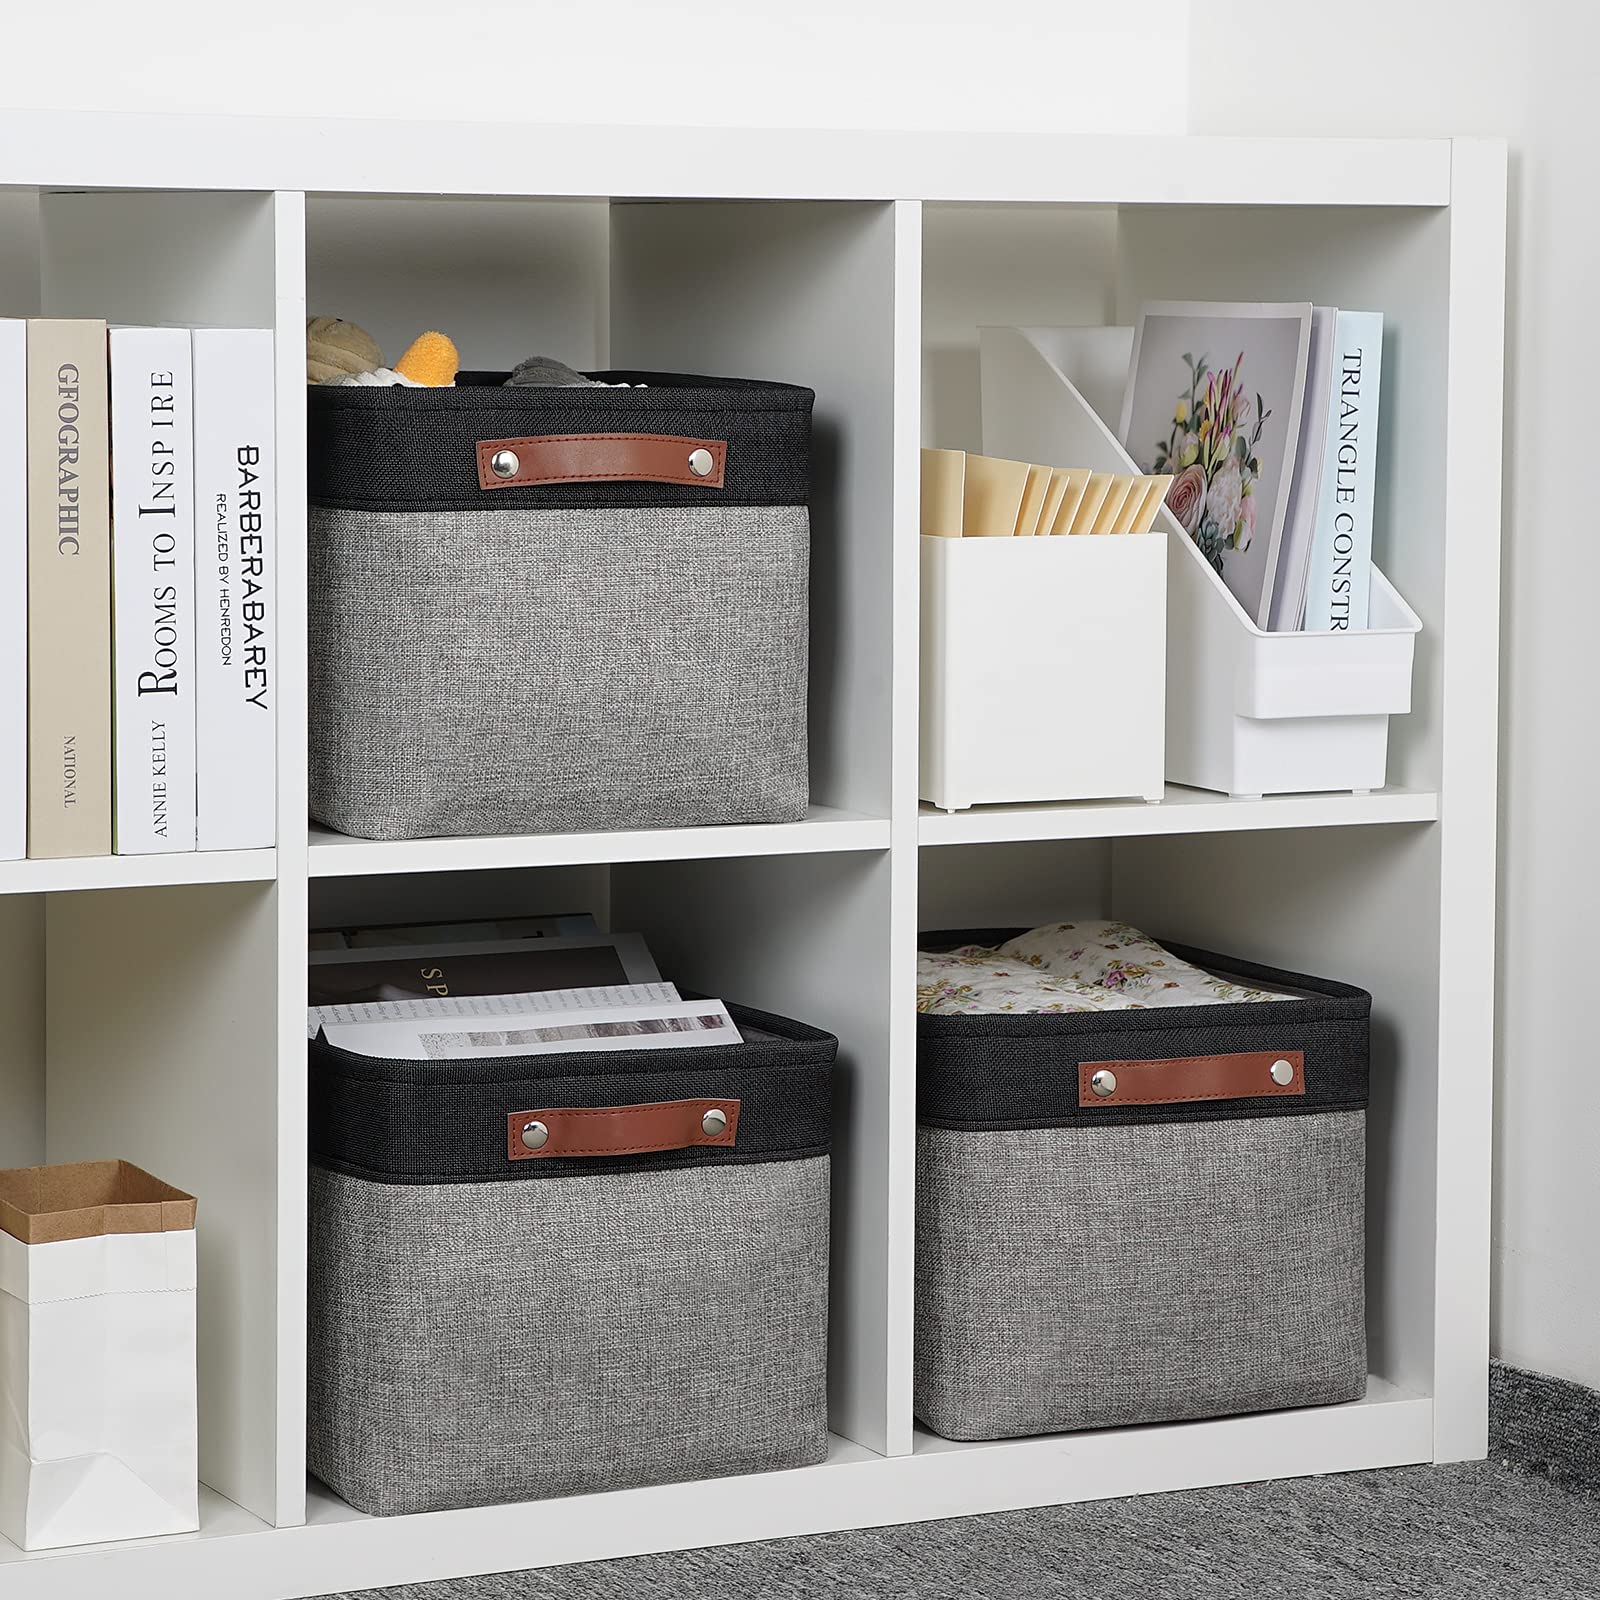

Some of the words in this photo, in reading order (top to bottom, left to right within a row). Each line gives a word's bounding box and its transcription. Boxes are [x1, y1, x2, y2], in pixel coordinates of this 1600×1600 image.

[1335, 348, 1362, 504] TRIANGLE
[153, 533, 176, 571] TO
[216, 493, 229, 562] REALIZED
[218, 566, 230, 584] BY
[237, 445, 268, 710] BARBERABAREY
[1330, 512, 1354, 631] CONSTR
[219, 588, 232, 666] HENREDON
[63, 735, 77, 808] NATIONAL
[151, 720, 166, 776] KELLY
[153, 782, 168, 838] ANNIE
